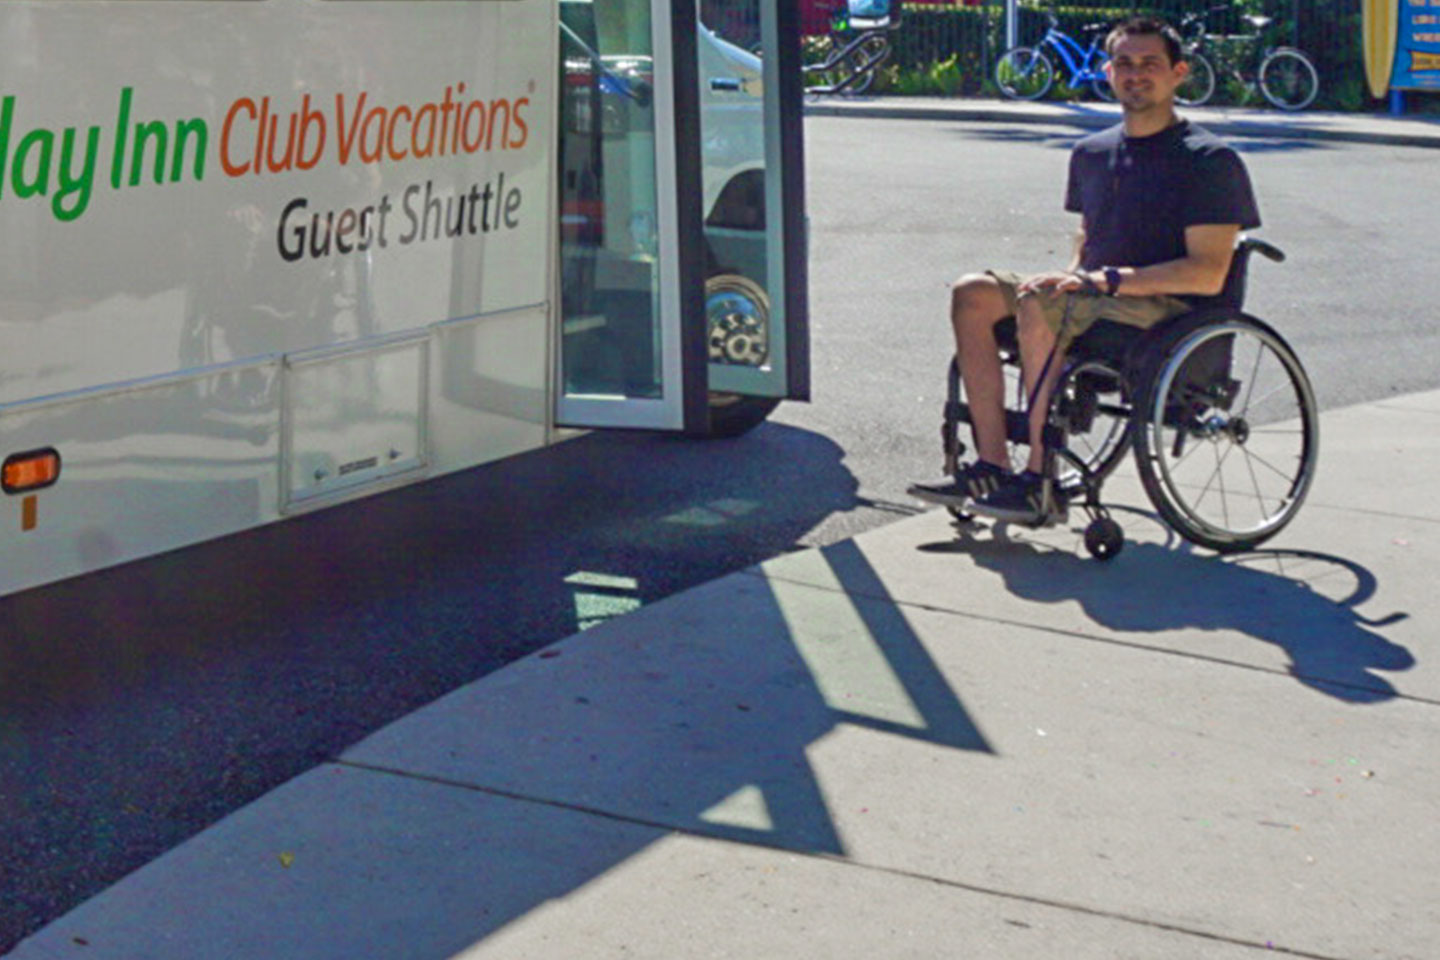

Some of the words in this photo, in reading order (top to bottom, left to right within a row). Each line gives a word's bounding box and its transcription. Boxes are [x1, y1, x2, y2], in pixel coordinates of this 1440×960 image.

[109, 86, 208, 191] Inn
[218, 93, 327, 178] Club
[335, 81, 530, 166] Vacations
[276, 195, 392, 263] Guest
[399, 171, 522, 245] Shuttle
